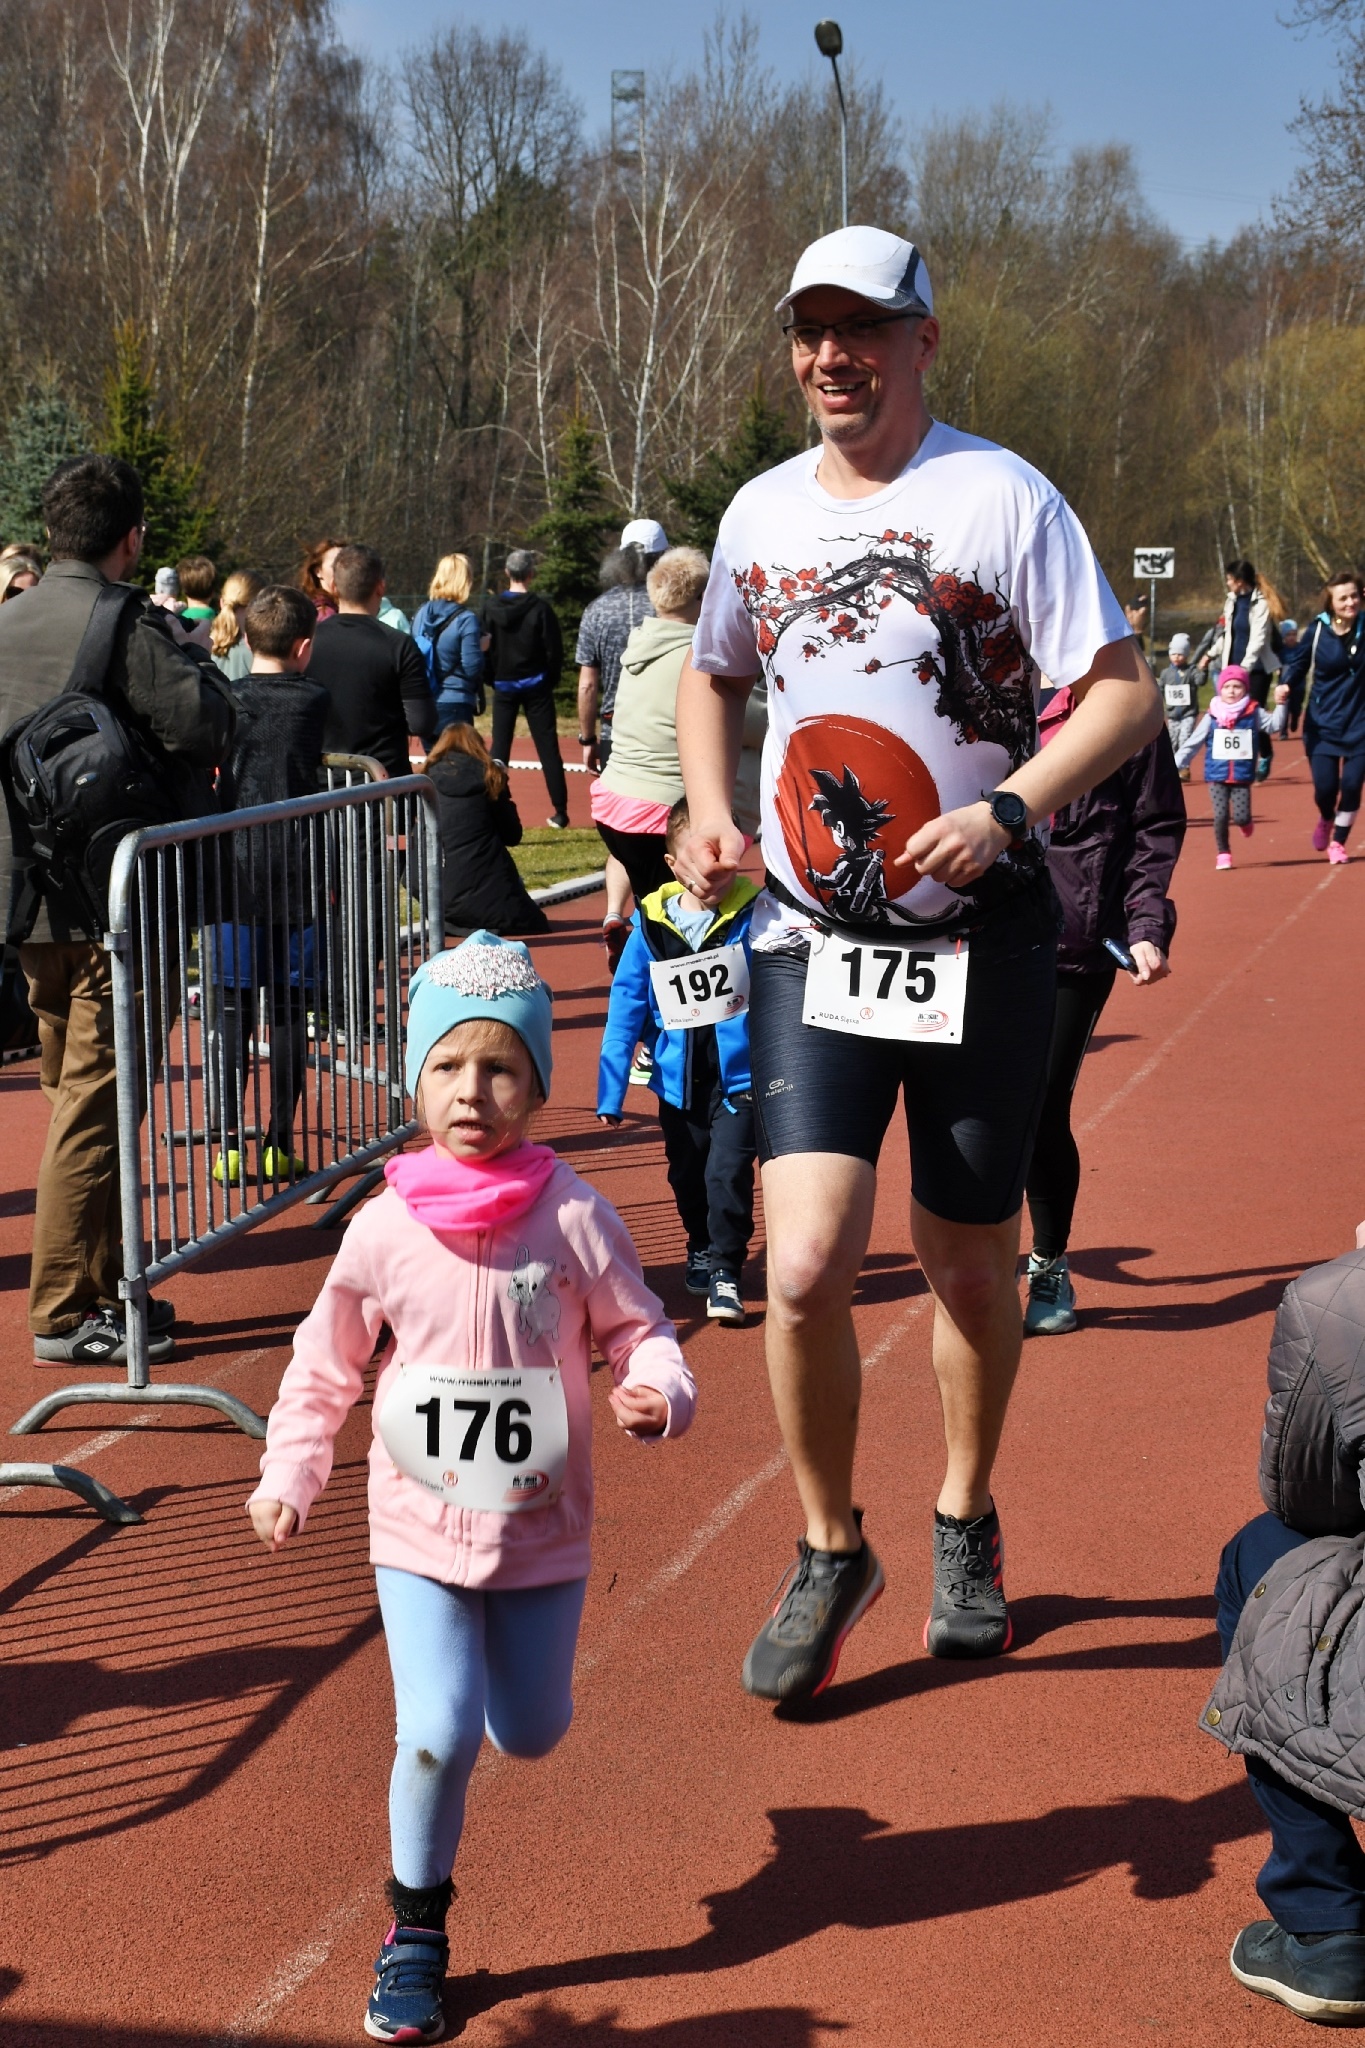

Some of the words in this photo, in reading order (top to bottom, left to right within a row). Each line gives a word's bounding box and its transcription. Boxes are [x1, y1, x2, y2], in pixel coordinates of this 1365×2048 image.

[1224, 736, 1240, 749] 66
[669, 964, 734, 1005] 192
[841, 947, 936, 1003] 175
[415, 1397, 533, 1464] 176
